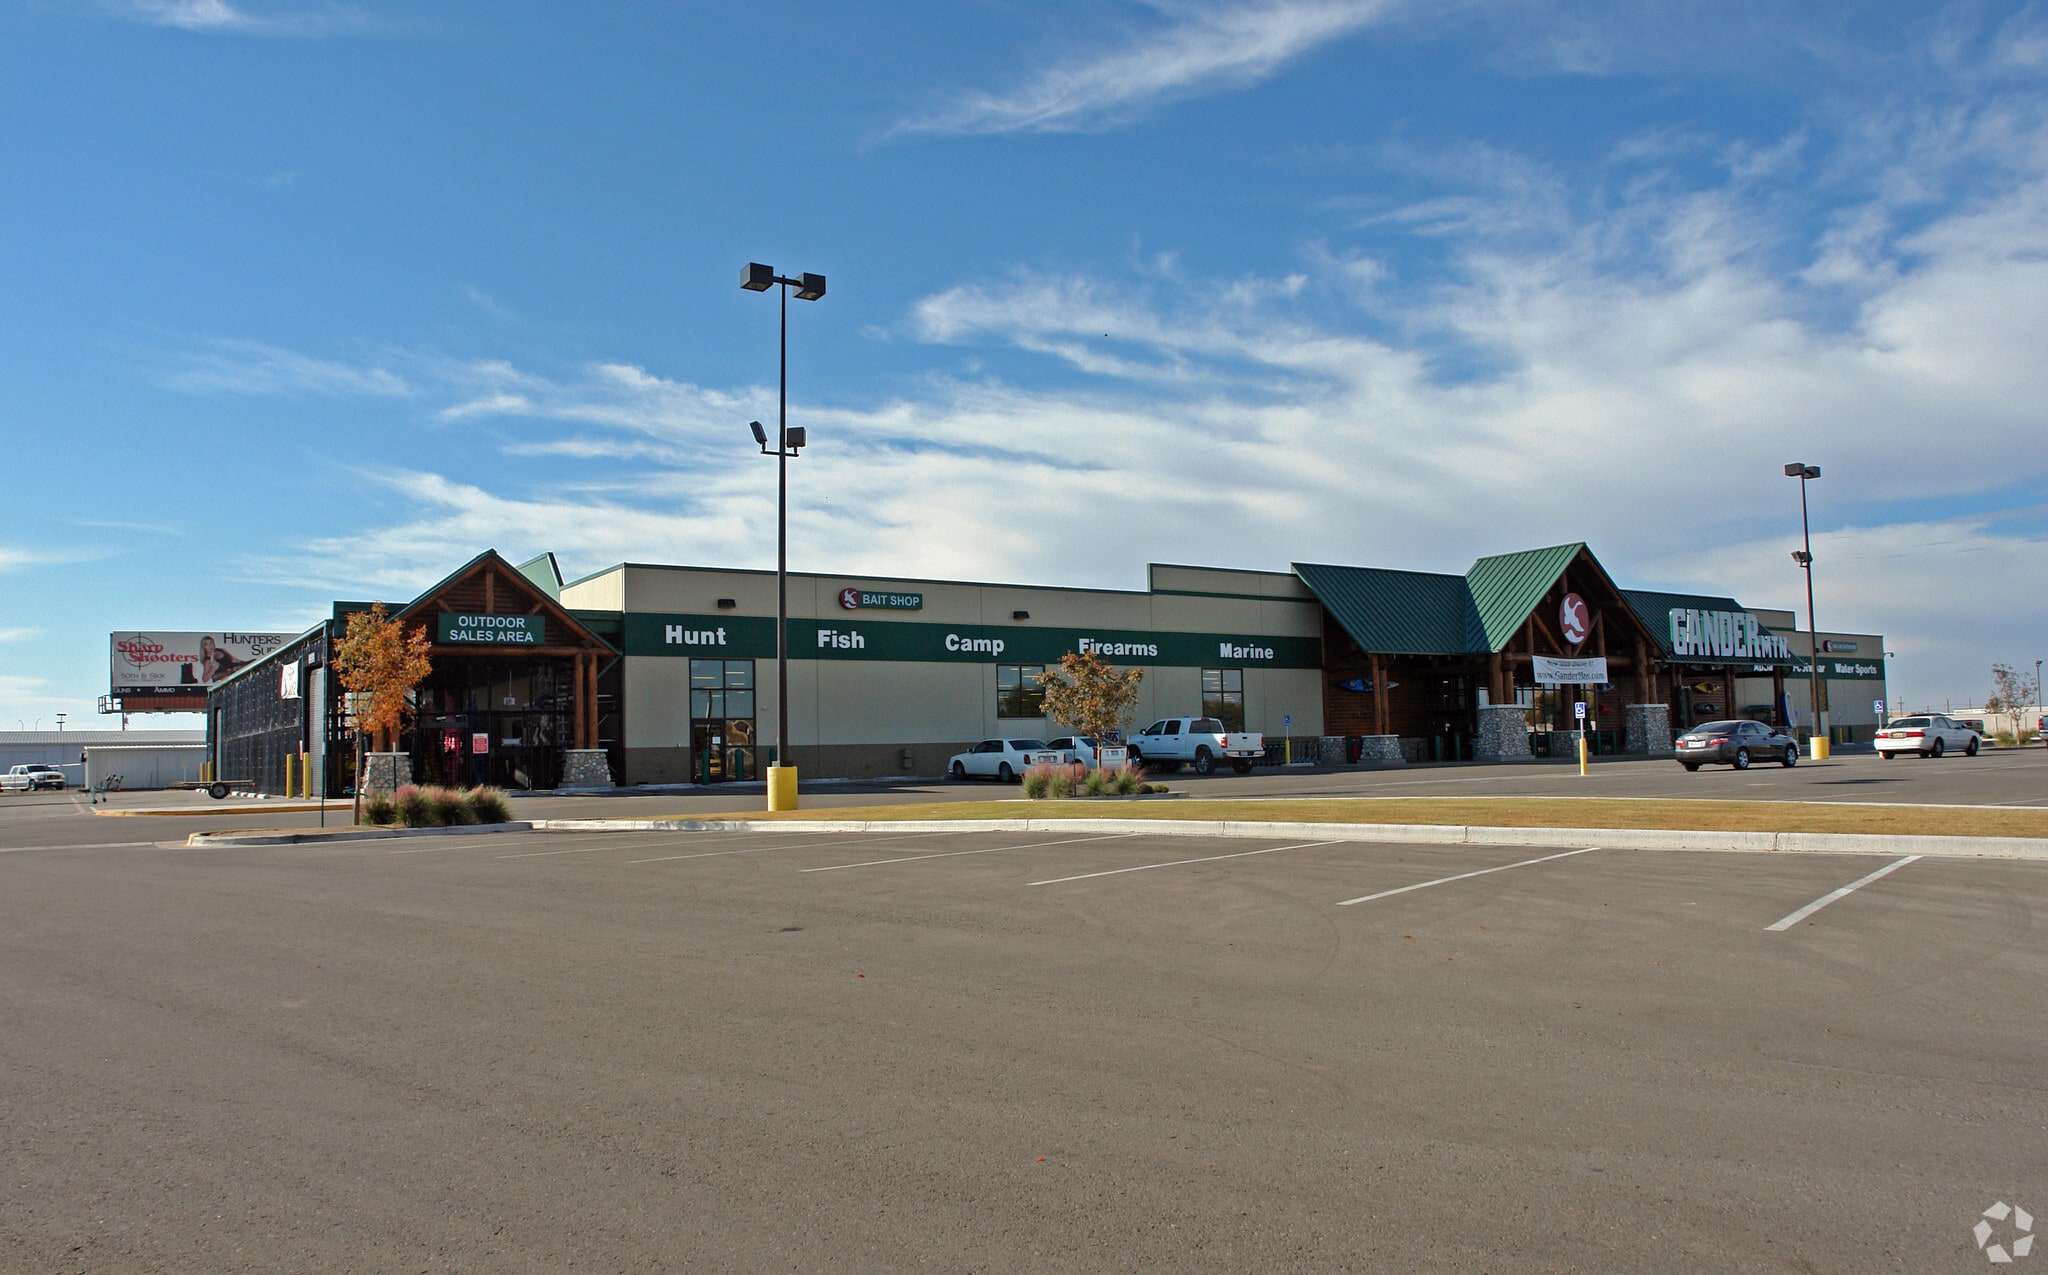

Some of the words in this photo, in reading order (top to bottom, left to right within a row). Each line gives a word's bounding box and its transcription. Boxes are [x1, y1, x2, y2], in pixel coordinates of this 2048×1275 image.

[861, 593, 887, 606] BAIT
[889, 595, 921, 608] SHOP
[458, 615, 526, 629] OUTDOOR
[449, 629, 493, 642] SALES
[496, 631, 534, 643] AREA
[664, 624, 727, 647] Hunt
[817, 628, 866, 649] Fish
[1669, 607, 1760, 659] GANDER
[1761, 635, 1791, 660] MTN.
[117, 641, 164, 655] Sharp
[944, 634, 1006, 657] Camp
[1078, 637, 1159, 657] Firearms
[1219, 642, 1275, 661] Marine
[129, 651, 199, 663] Shooters
[1834, 663, 1854, 674] Water
[1854, 663, 1878, 676] Sports
